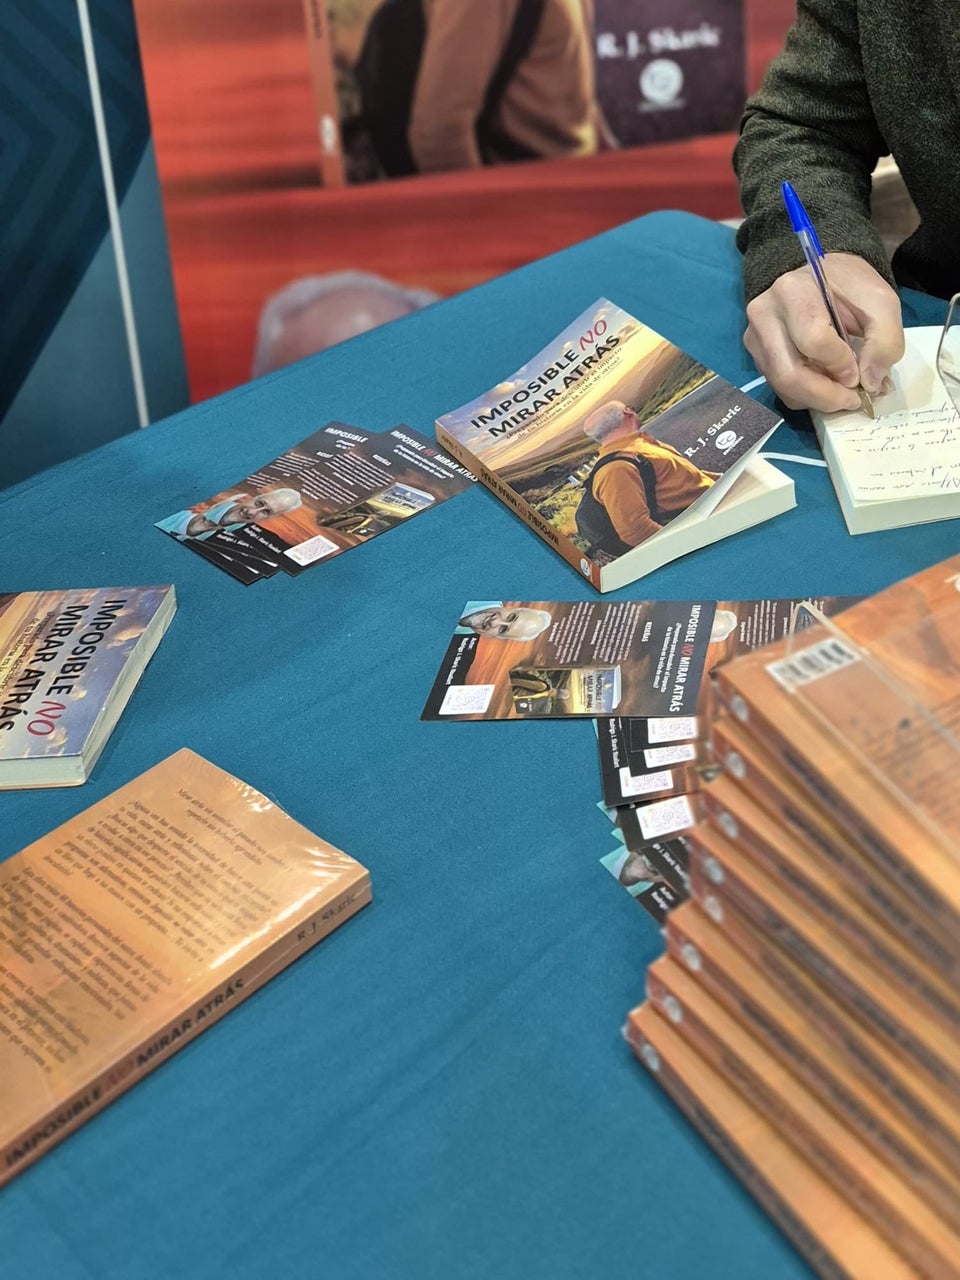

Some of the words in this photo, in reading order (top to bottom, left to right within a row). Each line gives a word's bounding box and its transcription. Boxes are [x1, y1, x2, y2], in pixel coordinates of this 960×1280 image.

[470, 349, 580, 430] IMPOSIBLE
[578, 319, 608, 352] NO
[595, 346, 624, 371] impacto
[487, 388, 561, 439] MIRAR
[561, 332, 622, 390] ATRÁS
[516, 430, 526, 439] de
[534, 403, 563, 427] historia
[562, 398, 572, 407] en
[571, 392, 579, 400] la
[577, 380, 594, 395] vida
[591, 373, 602, 383] de
[325, 427, 369, 444] IMPOSIBLE
[391, 430, 426, 451] IMPOSIBLE
[434, 452, 460, 470] MIRAR
[684, 443, 699, 458] R.
[697, 433, 709, 447] J.
[706, 402, 741, 437] Skaric
[29, 605, 90, 665] MIRAR
[45, 599, 128, 696] IMPOSIBLE
[684, 604, 701, 643] IMPOSIBLE
[675, 655, 690, 684] MIRAR
[681, 642, 694, 656] NO
[0, 668, 46, 731] ATRÁS
[27, 700, 66, 736] NO
[668, 684, 686, 713] ATRÁS
[6, 1087, 101, 1167] IMPOSIBLE
[136, 1018, 193, 1069] MIRAR
[195, 977, 245, 1024] ATRÁS
